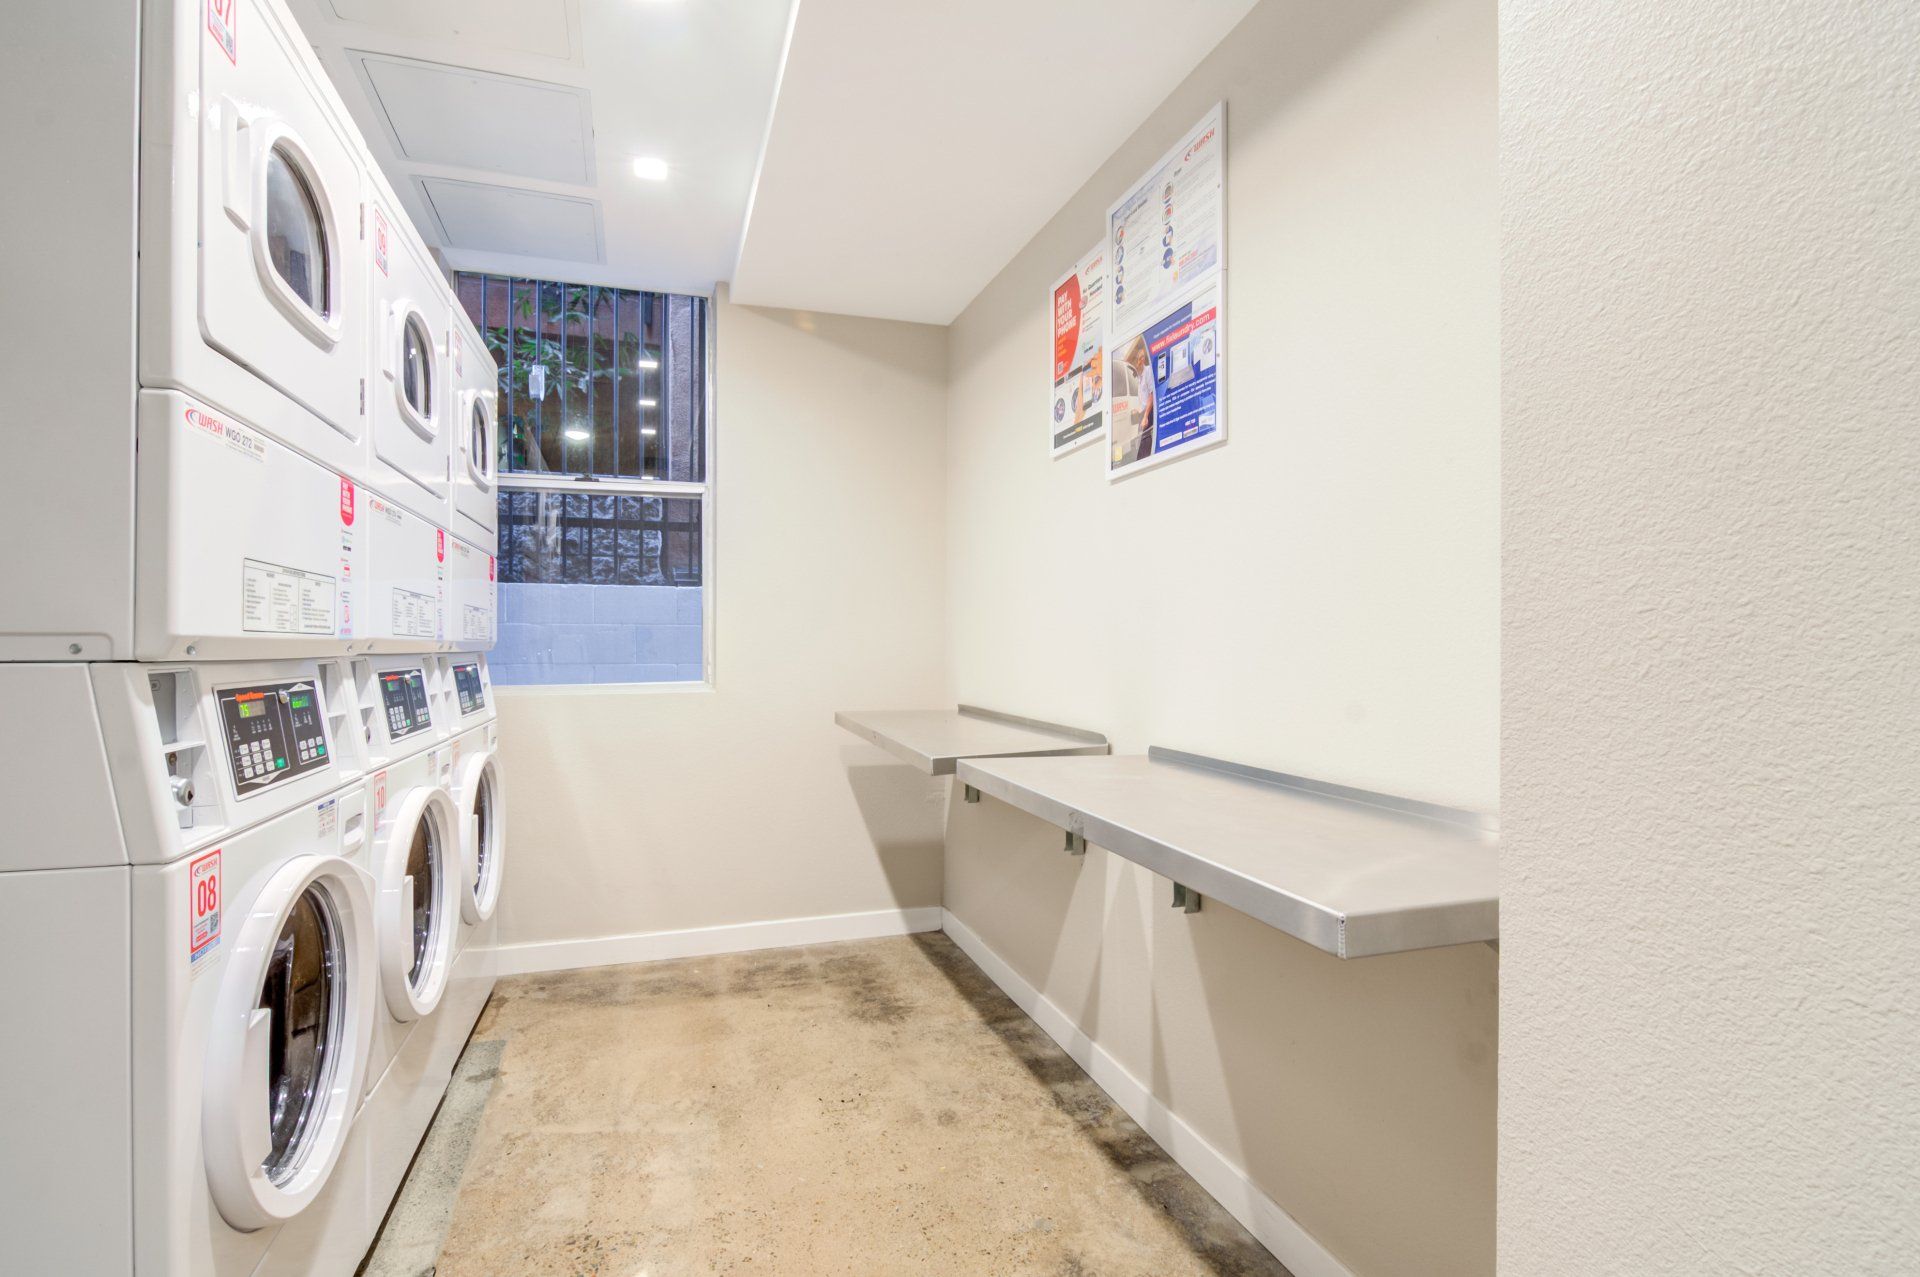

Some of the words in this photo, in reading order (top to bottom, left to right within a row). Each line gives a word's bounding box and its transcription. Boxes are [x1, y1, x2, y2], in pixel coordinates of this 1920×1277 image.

[1057, 290, 1068, 307] PAY
[1057, 298, 1072, 319] WITH
[1057, 308, 1073, 329] YOUR
[1057, 315, 1077, 339] PHONE
[198, 412, 224, 436] WASH
[197, 874, 216, 917] 08
